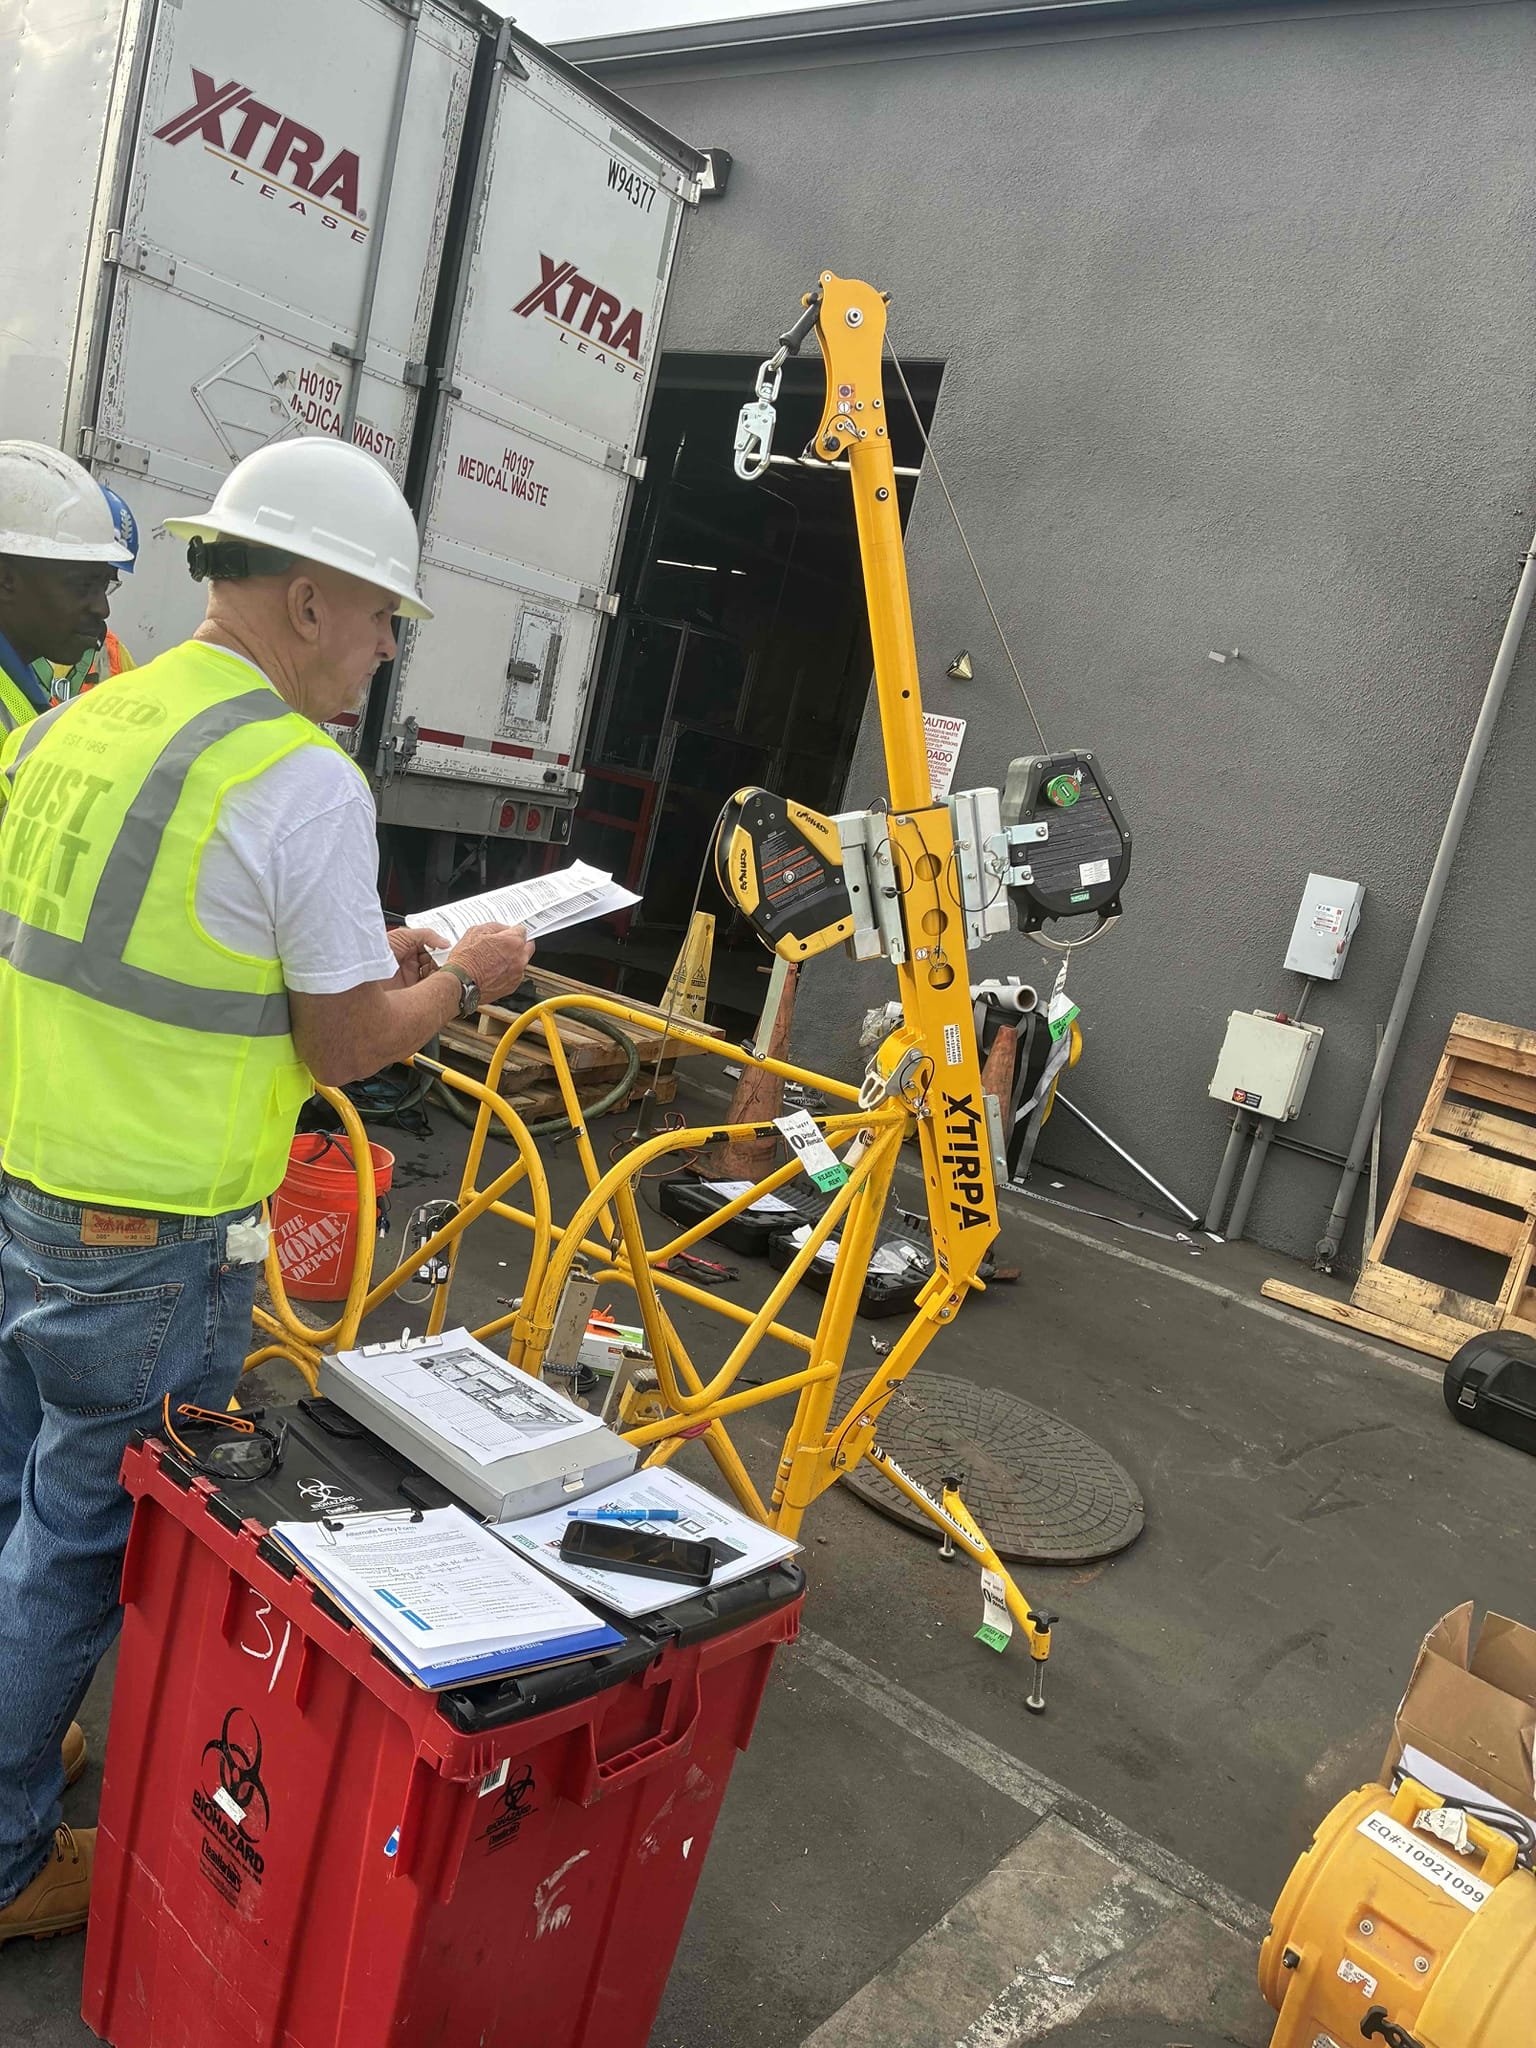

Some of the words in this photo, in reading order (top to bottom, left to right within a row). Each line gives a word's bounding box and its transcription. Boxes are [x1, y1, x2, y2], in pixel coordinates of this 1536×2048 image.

[152, 68, 360, 216] XTRA
[230, 170, 367, 244] LEASE
[607, 158, 657, 213] W94377
[512, 252, 643, 361] XTRA
[559, 332, 644, 382] LEASE
[298, 367, 342, 405] H0197
[457, 454, 508, 492] MEDICAL
[511, 474, 549, 507] WASTE
[502, 447, 535, 480] H0197
[81, 694, 161, 725] ABCO
[927, 749, 953, 763] DADO
[941, 1091, 990, 1231] XTIRPA
[278, 1214, 308, 1239] THE
[290, 1239, 343, 1282] DEPOT
[191, 1788, 265, 1875] BIOHAZARD
[1367, 1818, 1485, 1904] EQ#:10921099
